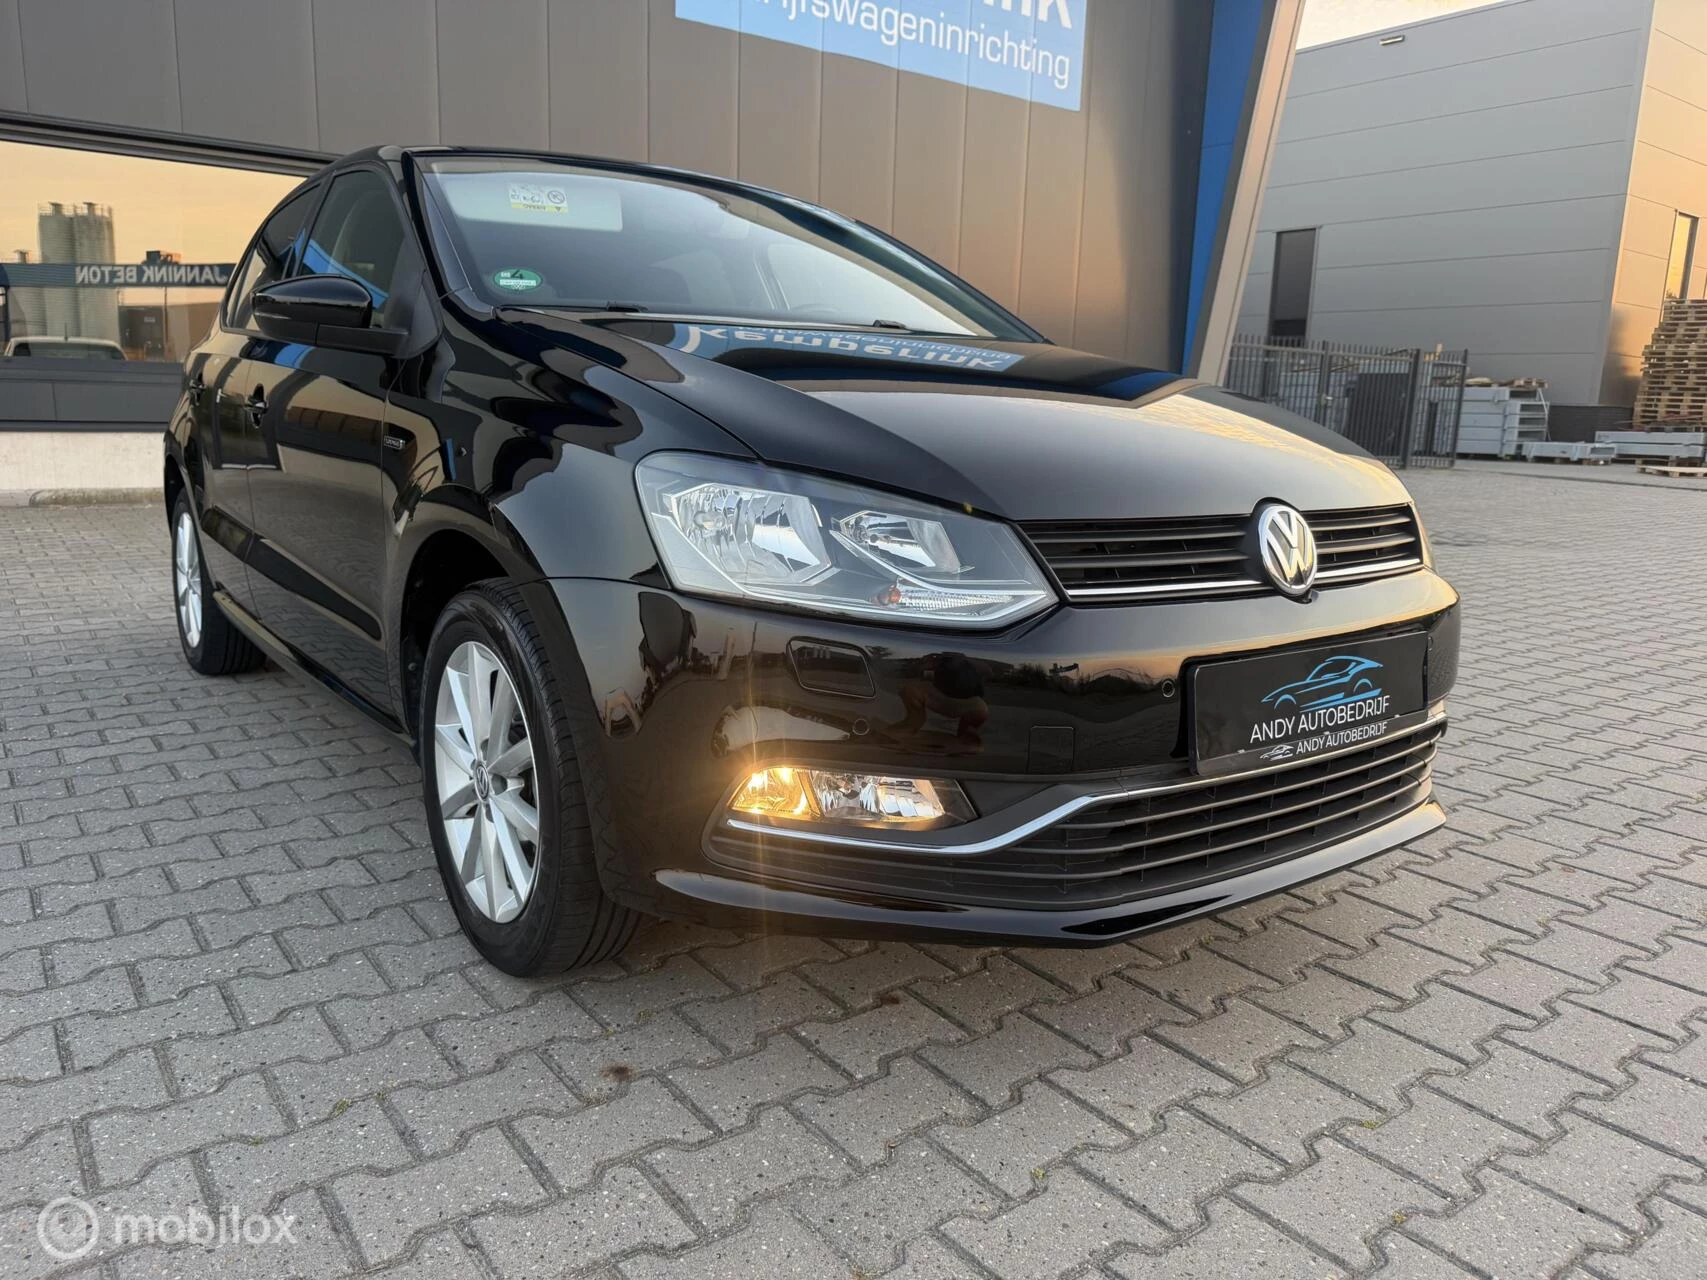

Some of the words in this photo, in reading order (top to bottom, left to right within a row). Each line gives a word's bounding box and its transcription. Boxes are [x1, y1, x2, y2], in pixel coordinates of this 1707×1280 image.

[754, 0, 1071, 90] swageninrichting
[1250, 715, 1296, 743] ANDY
[1298, 695, 1391, 733] AUTOBEDRIJF
[1296, 737, 1326, 755] ANDY
[1325, 721, 1388, 748] AUTOBEDRIJF
